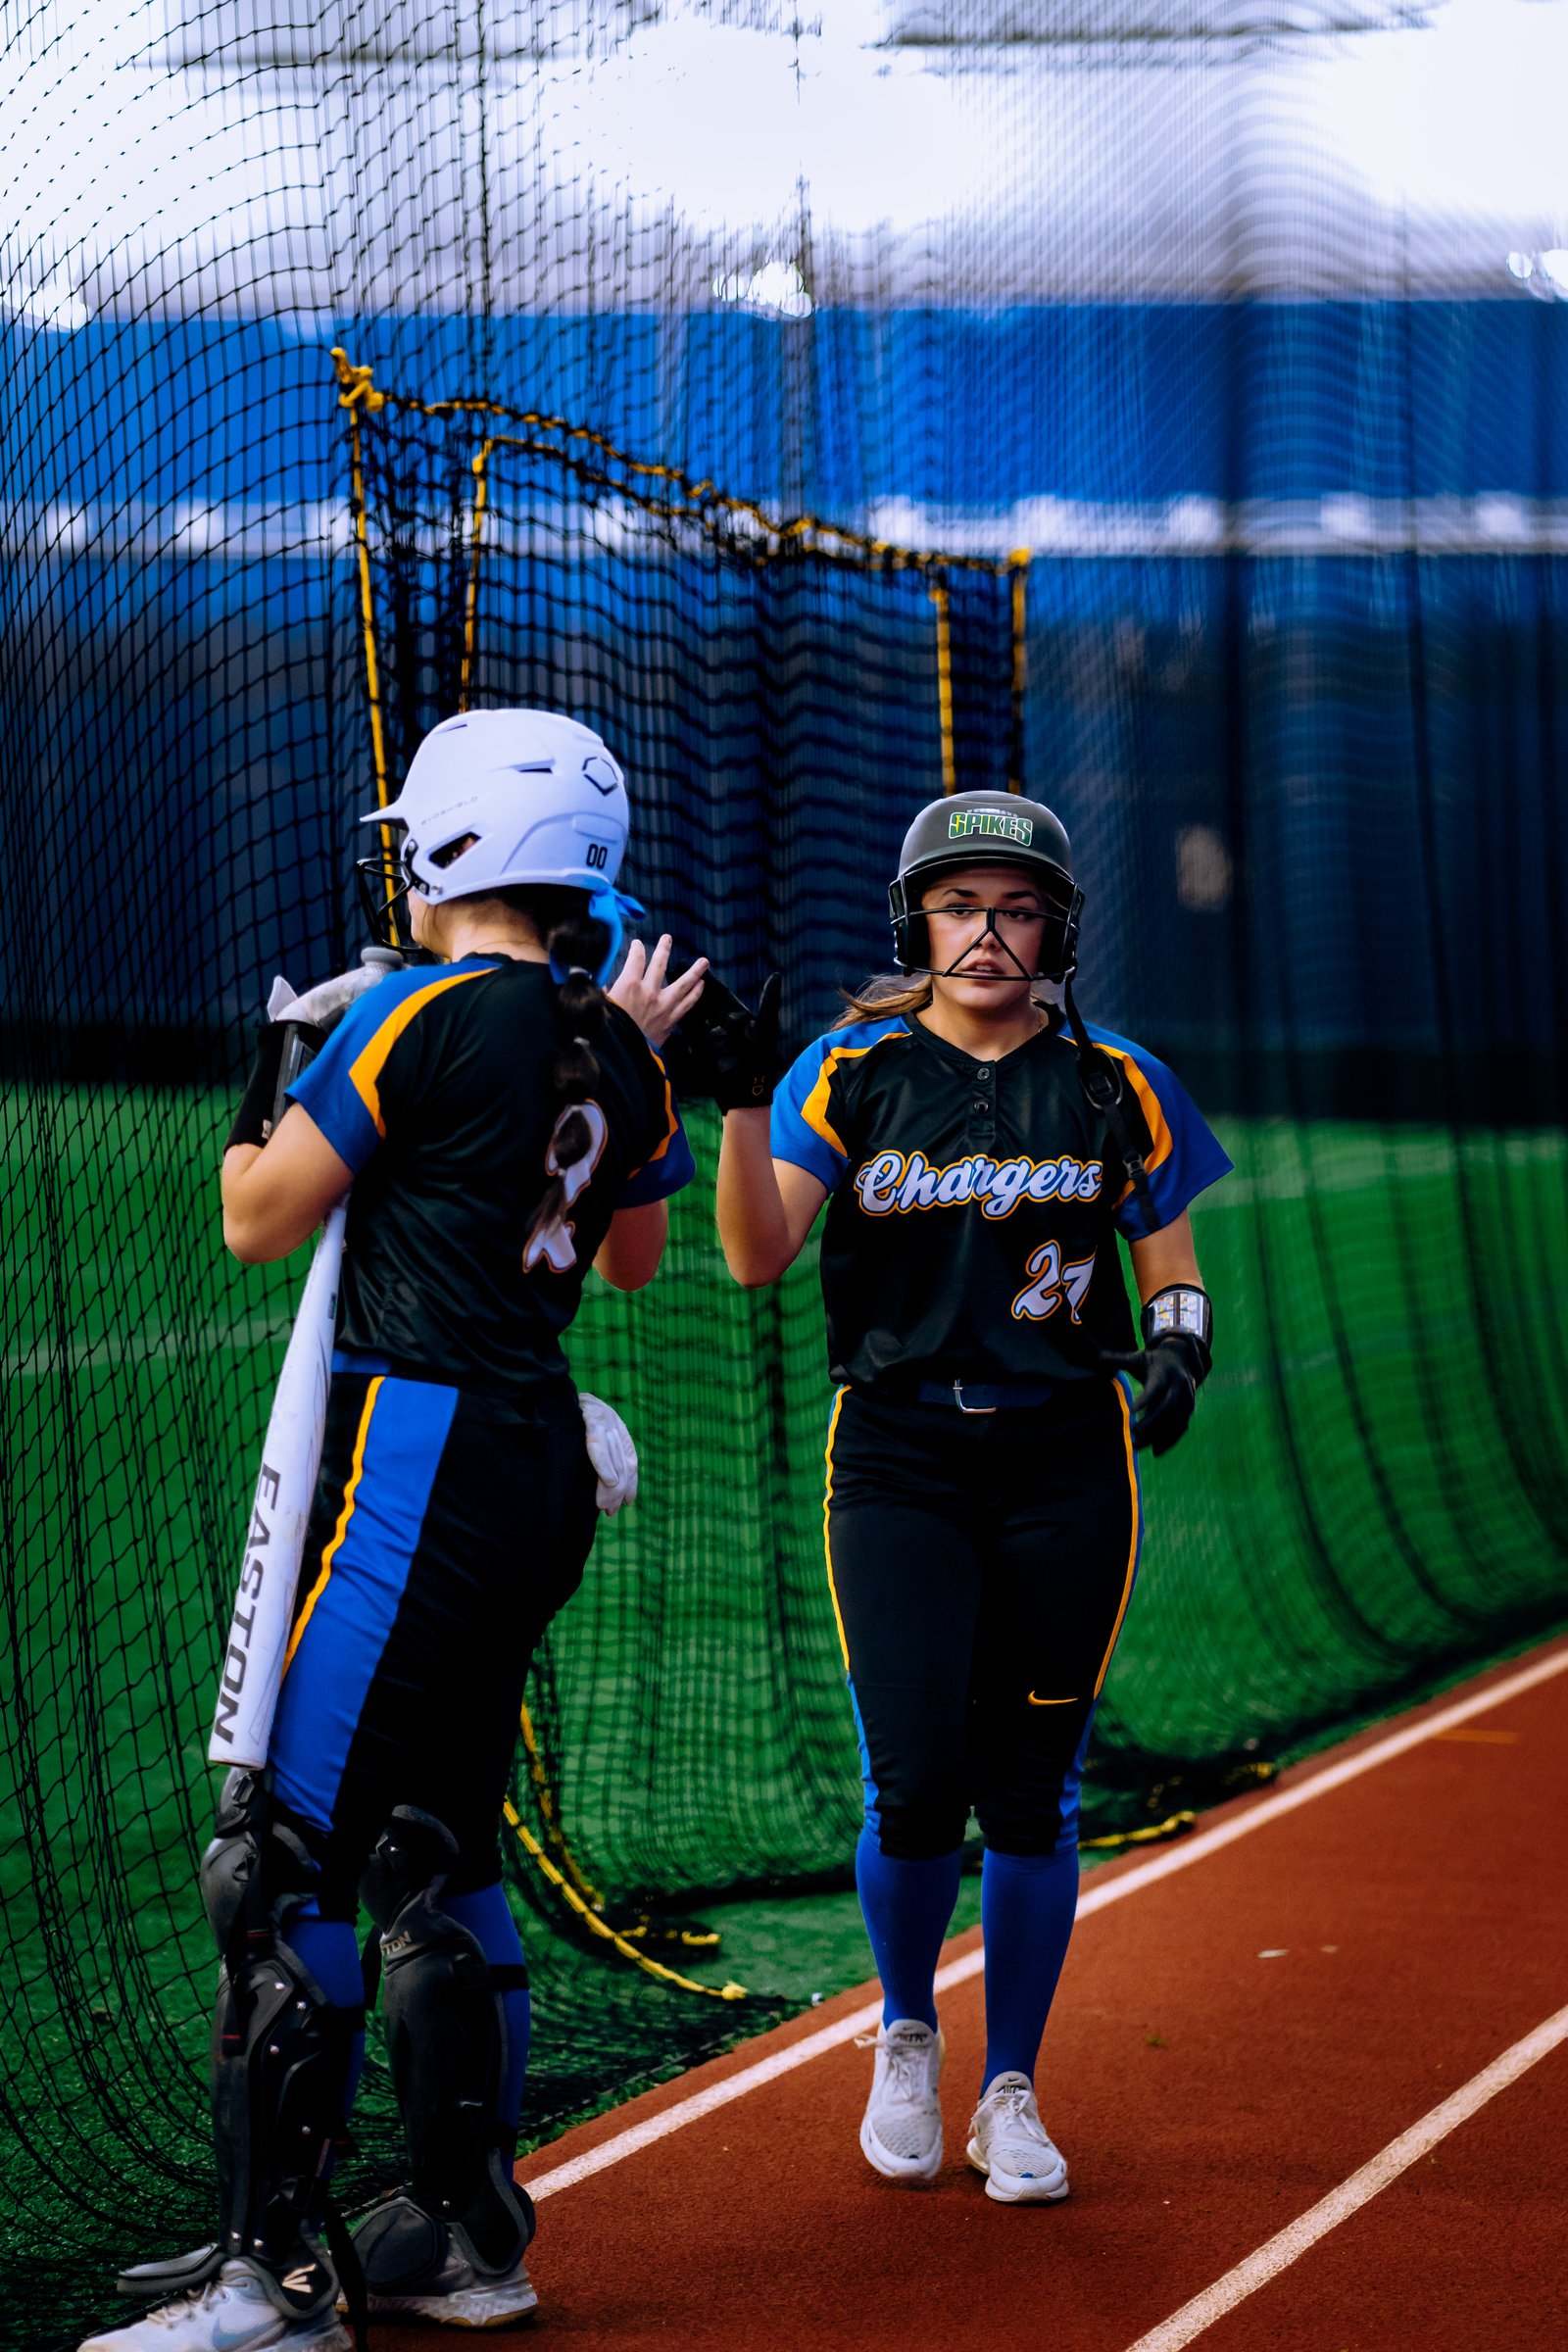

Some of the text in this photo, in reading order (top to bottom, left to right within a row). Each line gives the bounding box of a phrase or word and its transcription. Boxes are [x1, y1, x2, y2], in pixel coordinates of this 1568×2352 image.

[586, 843, 609, 870] 00
[949, 811, 1034, 847] SPIKES
[854, 1150, 1103, 1220] Chargers
[1010, 1239, 1098, 1325] 27
[214, 1462, 281, 1745] EASTON
